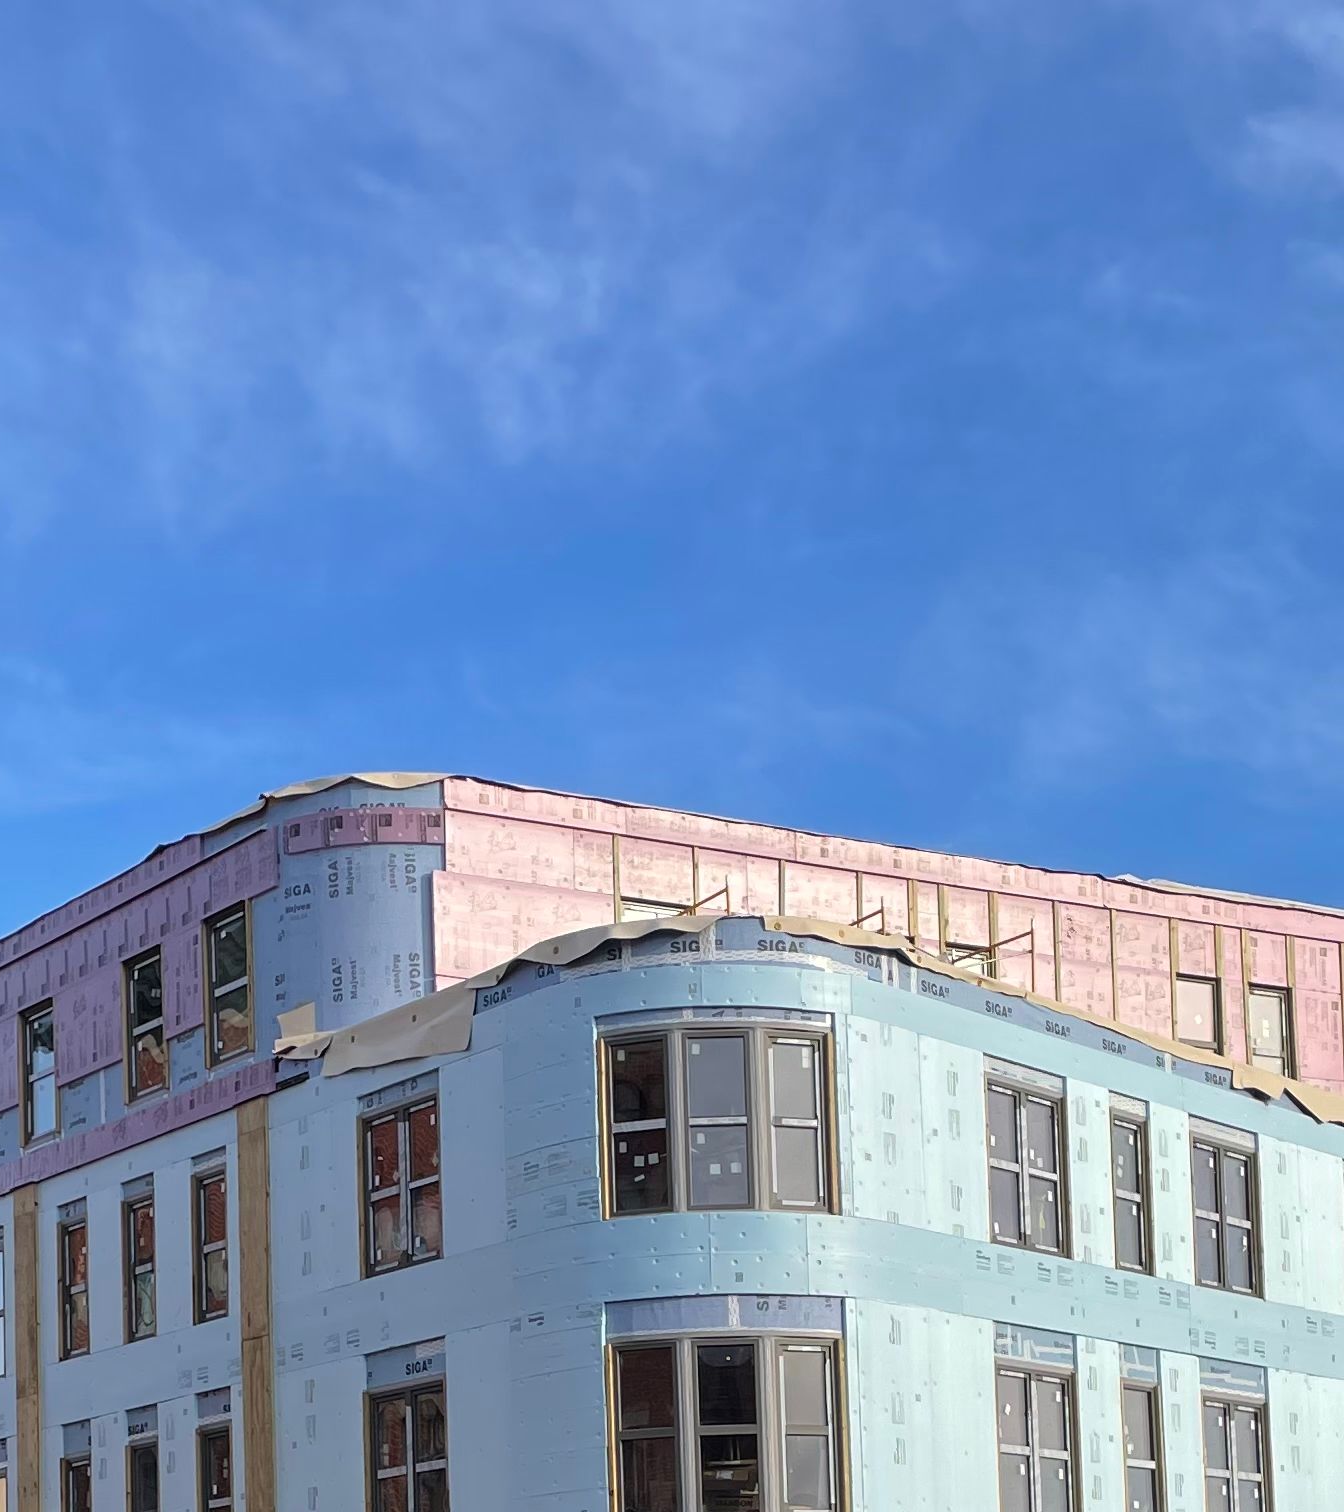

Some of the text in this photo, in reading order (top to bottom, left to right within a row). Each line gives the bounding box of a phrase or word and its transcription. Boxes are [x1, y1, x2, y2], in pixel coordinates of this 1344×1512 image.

[328, 860, 339, 898] SIGA
[670, 941, 700, 954] SIG
[757, 940, 799, 953] SIGA
[855, 951, 882, 970] SIGA
[409, 952, 420, 990] SIGA
[333, 965, 343, 1003] SIGA
[921, 981, 945, 999] SIGA
[483, 988, 508, 1007] SIGA
[985, 1001, 1008, 1018] SIGA
[1045, 1020, 1067, 1037] SIGA
[1102, 1038, 1124, 1055] SIGA
[1205, 1072, 1223, 1086] SIGA
[406, 1361, 429, 1375] SIGA
